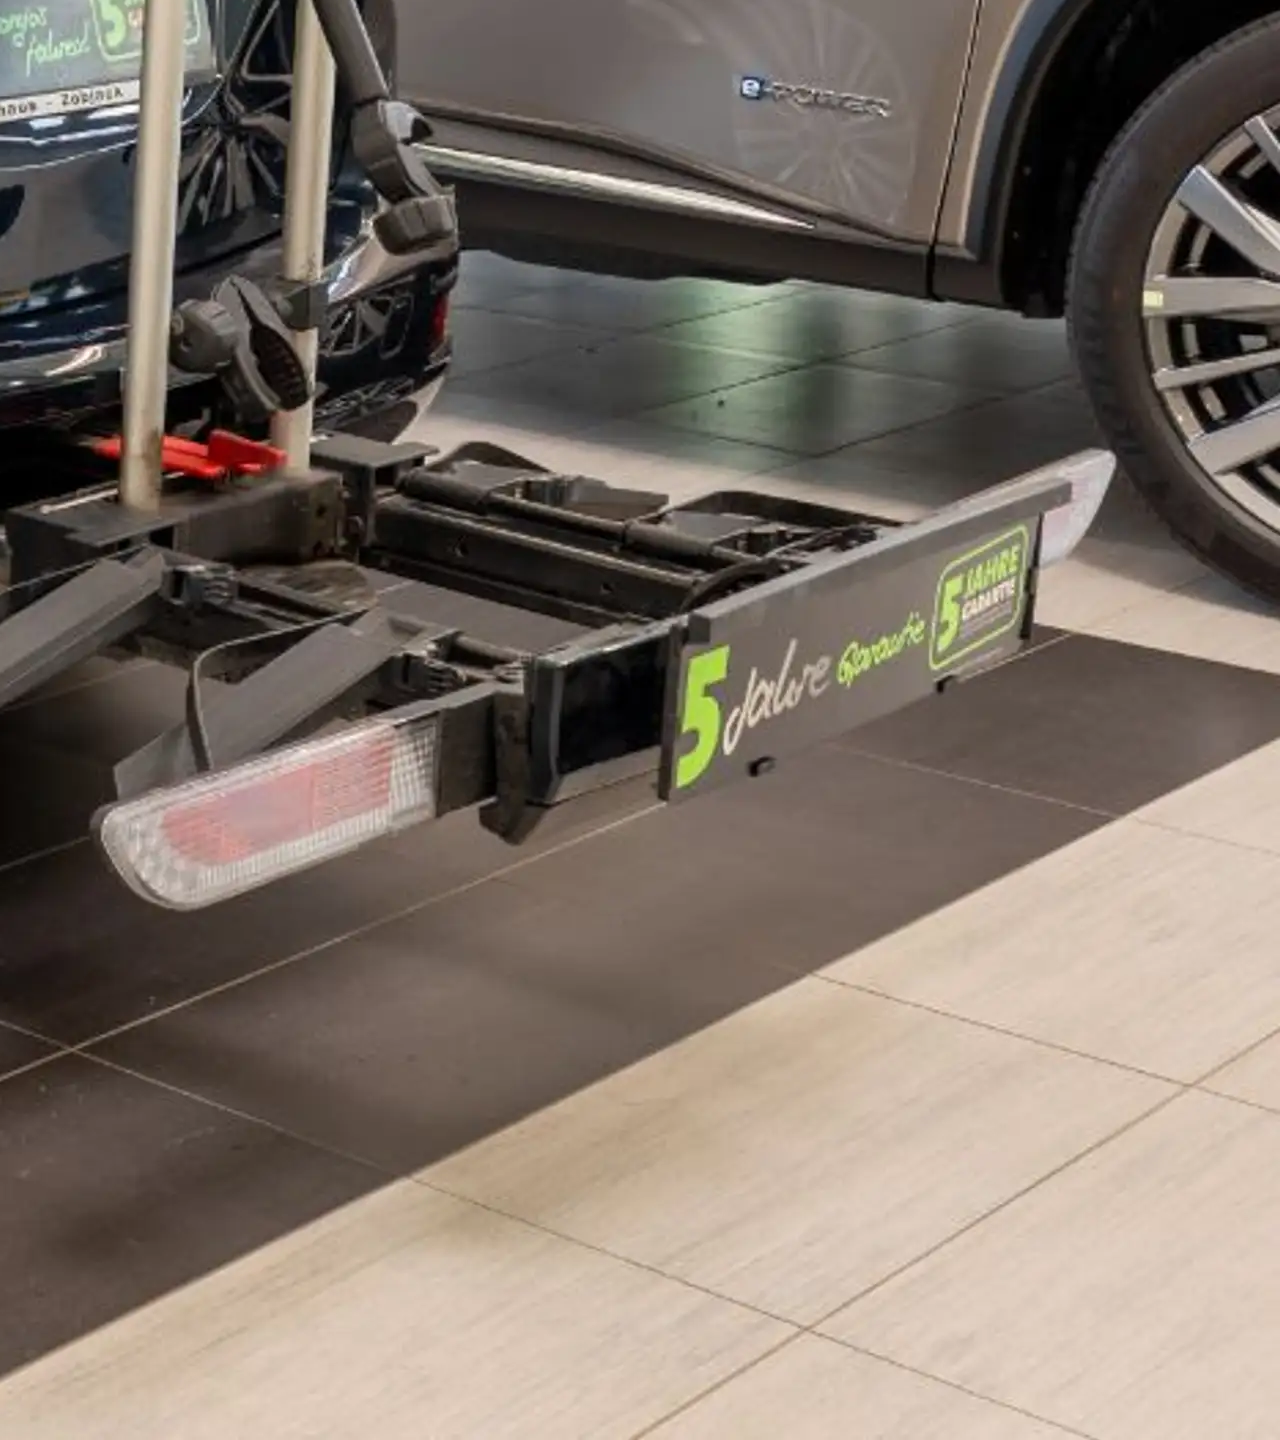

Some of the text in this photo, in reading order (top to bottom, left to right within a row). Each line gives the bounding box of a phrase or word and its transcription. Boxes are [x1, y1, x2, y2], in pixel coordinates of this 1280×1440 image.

[966, 543, 1021, 598] JAHRE
[937, 574, 962, 654] 5
[676, 644, 730, 789] 5
